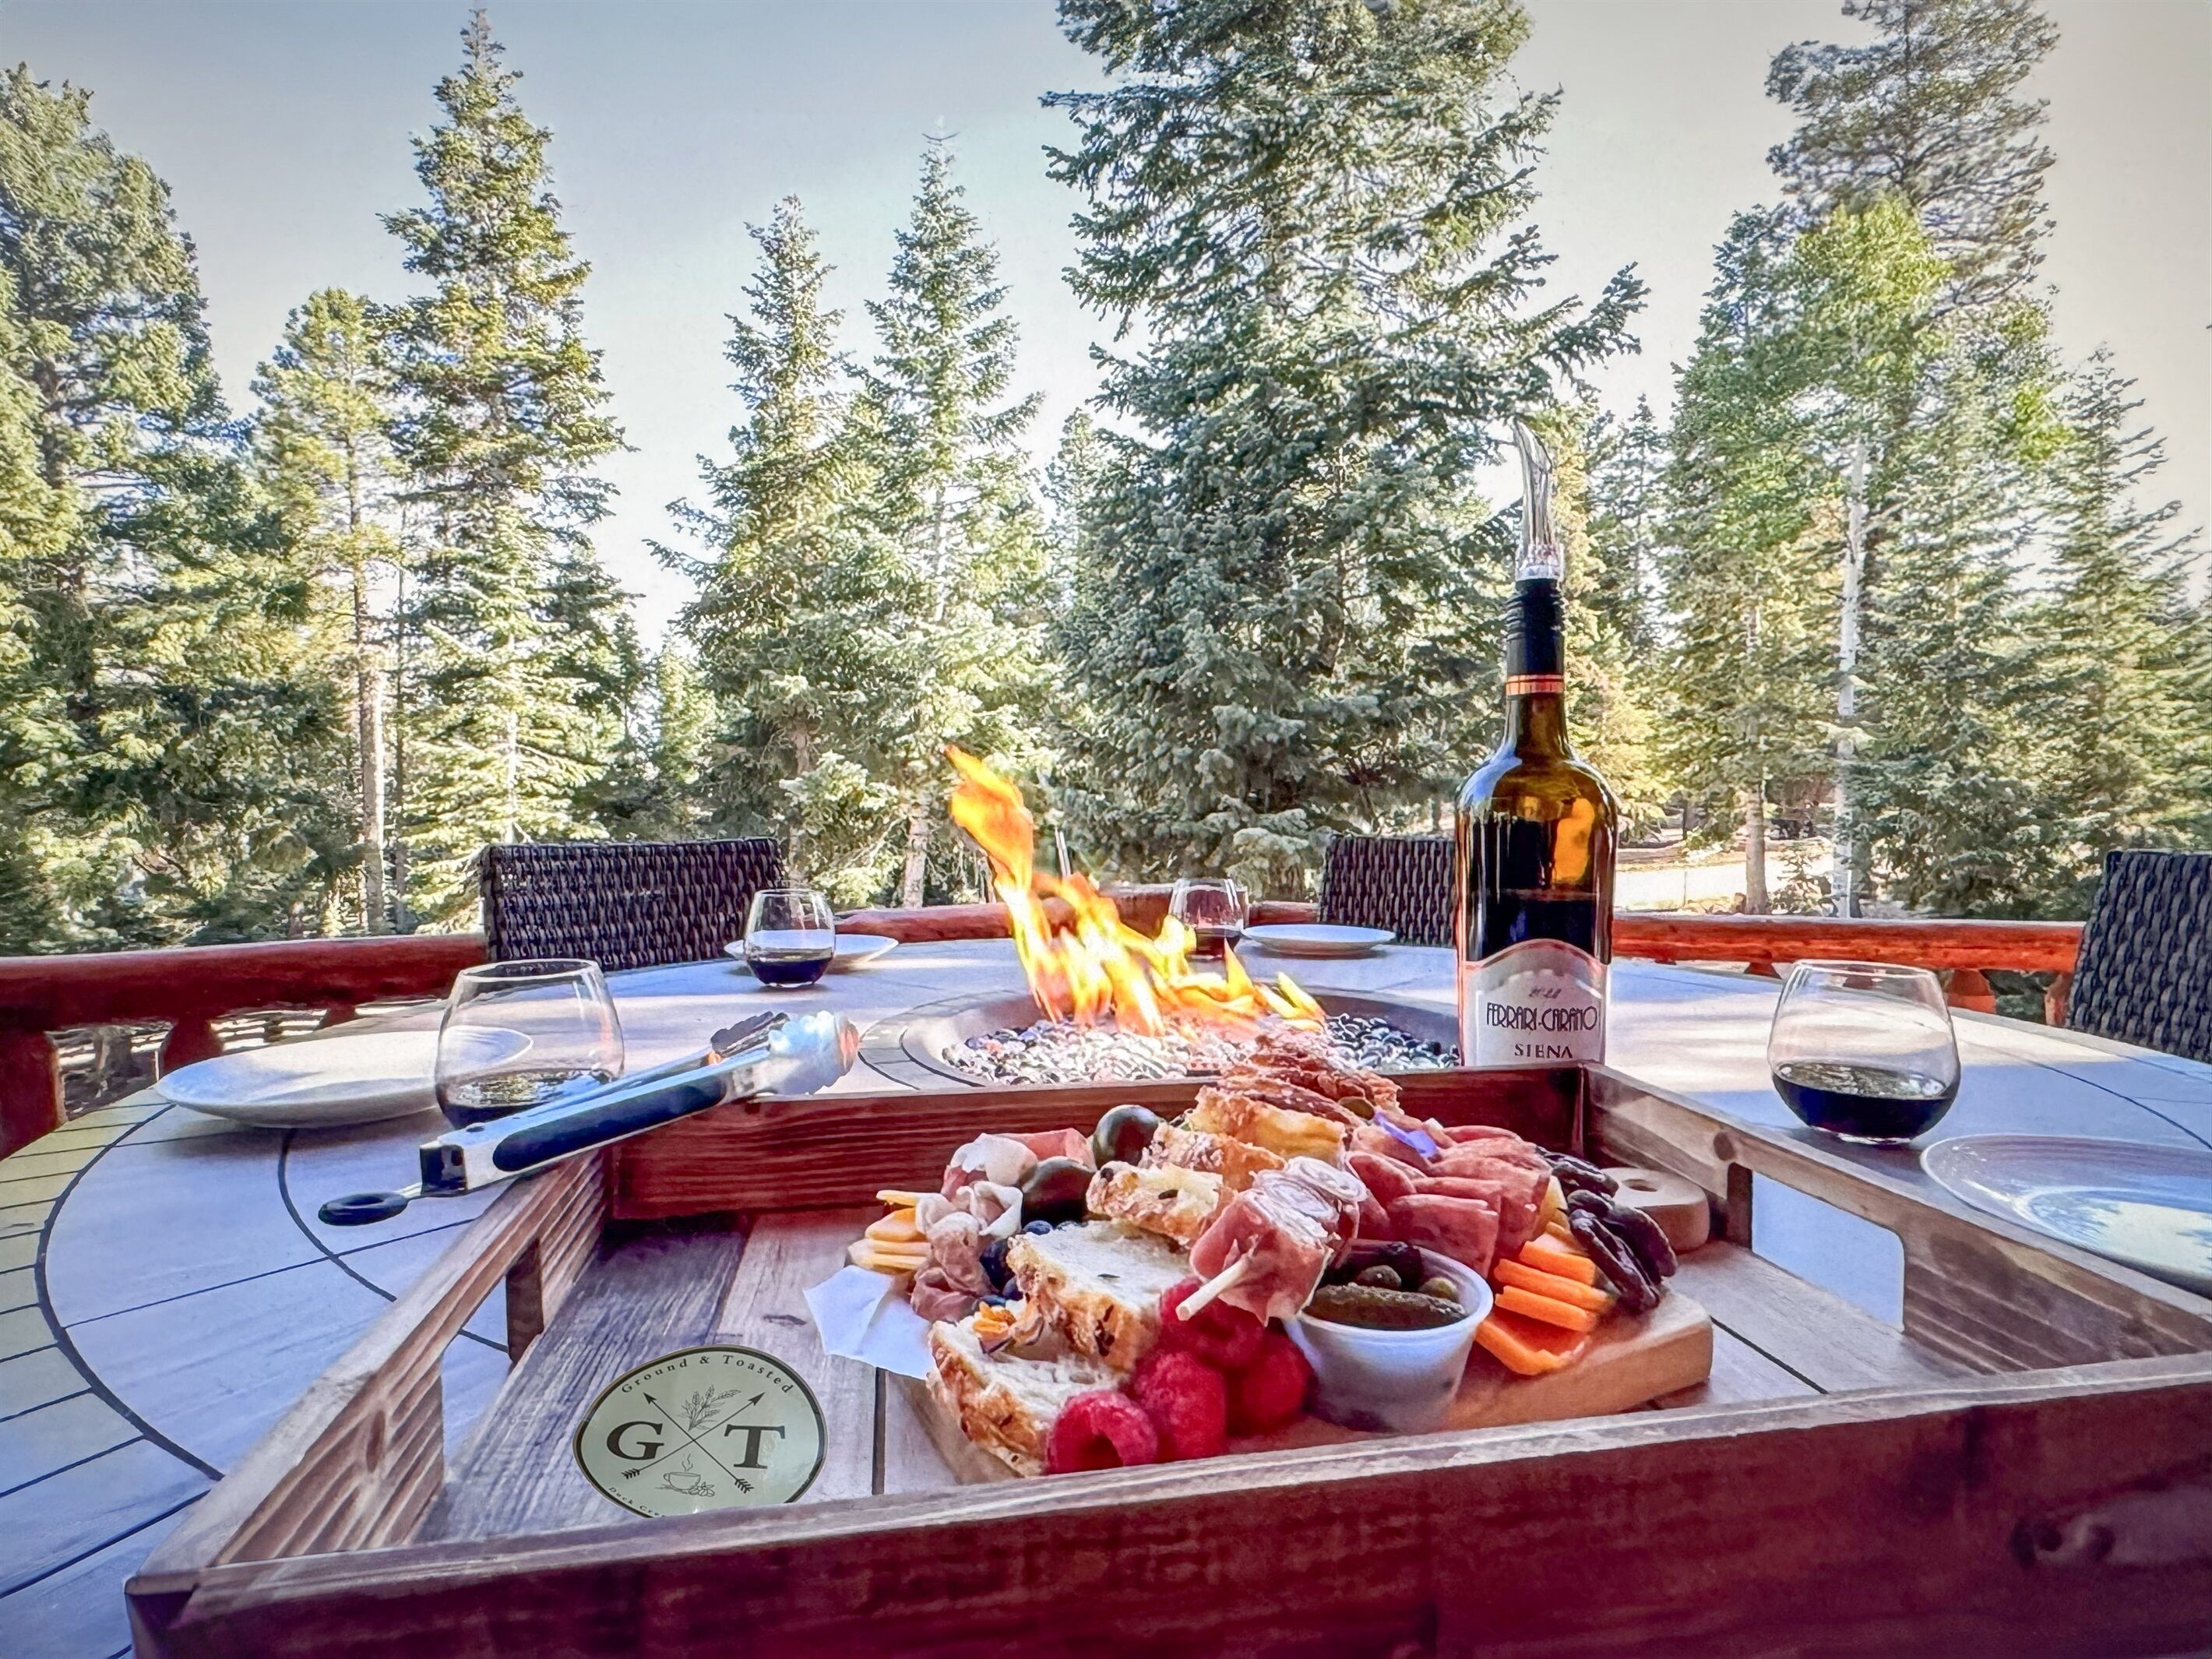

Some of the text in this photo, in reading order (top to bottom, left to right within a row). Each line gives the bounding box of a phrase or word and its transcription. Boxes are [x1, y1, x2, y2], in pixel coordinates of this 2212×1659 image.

[1514, 1044, 1573, 1058] SIENA
[621, 1354, 794, 1394] Ground & Toasted
[606, 1421, 786, 1470] G T
[609, 1487, 667, 1518] Duck Cree
